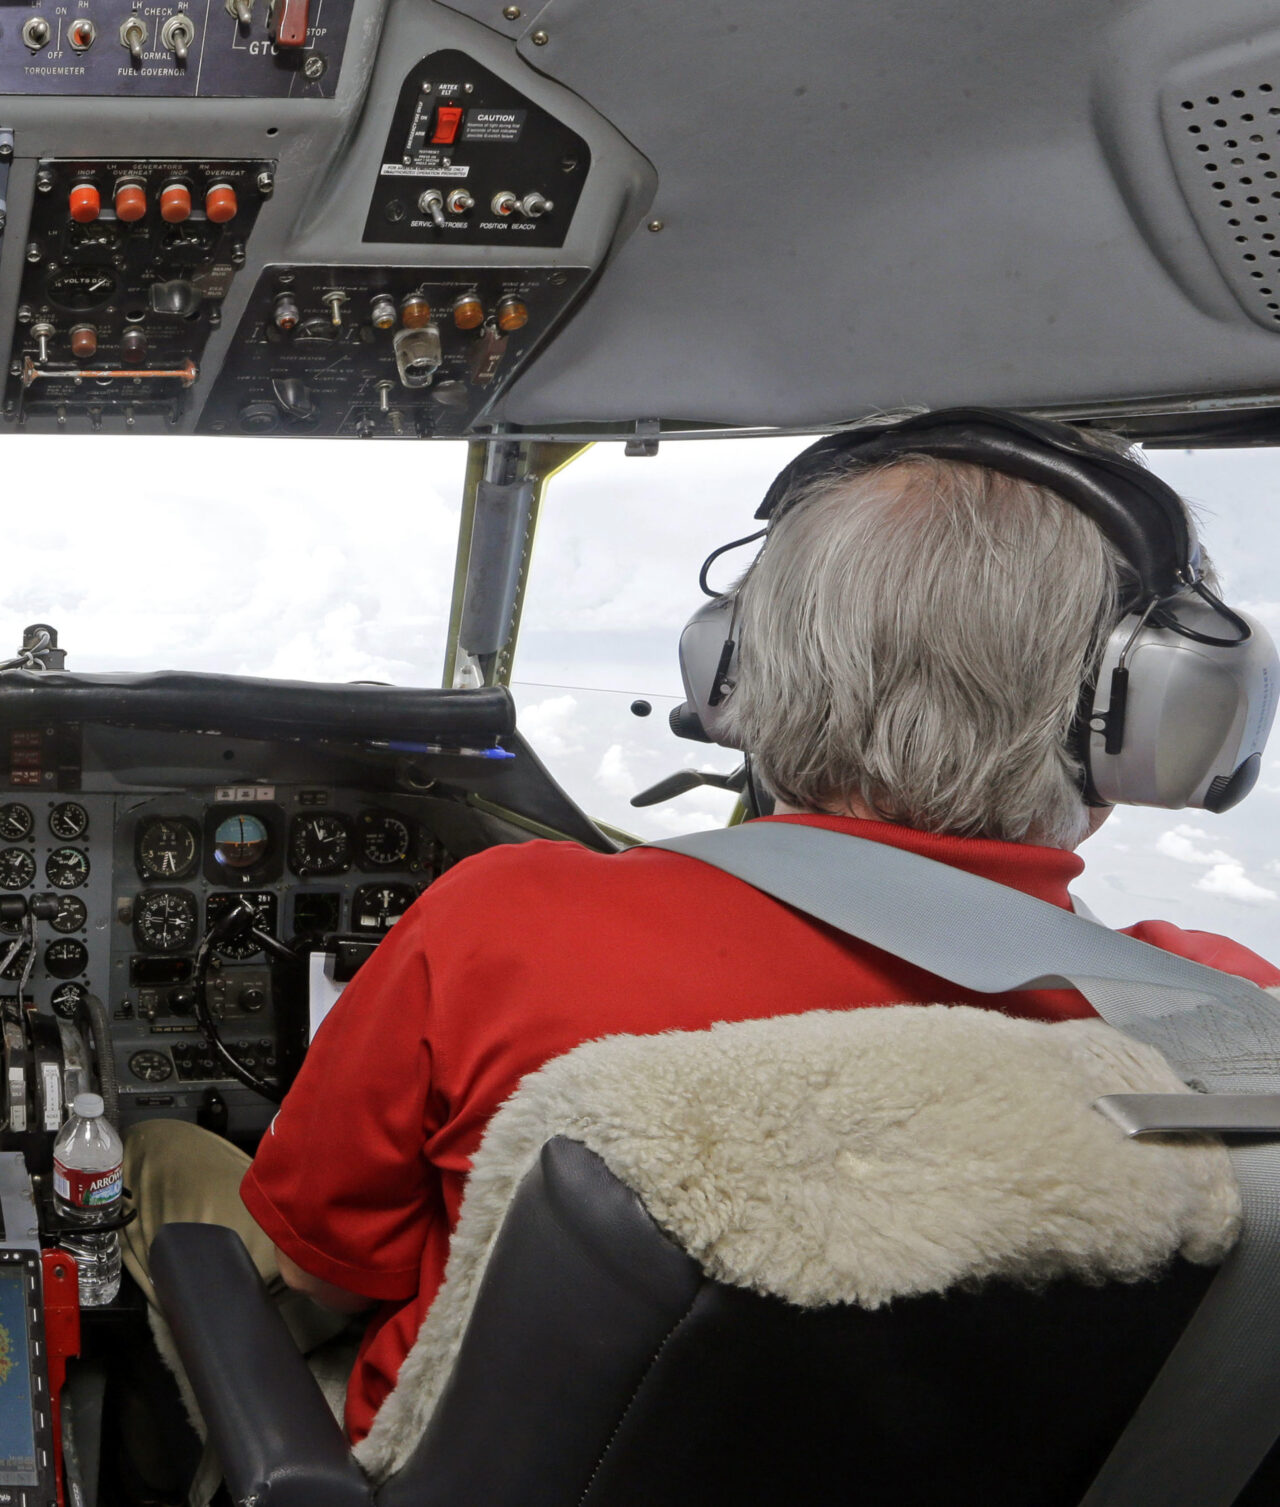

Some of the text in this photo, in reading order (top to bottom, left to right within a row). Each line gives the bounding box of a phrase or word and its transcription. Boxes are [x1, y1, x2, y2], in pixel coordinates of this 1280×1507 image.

[178, 1, 189, 9] RH
[144, 8, 173, 16] CHECK
[306, 28, 327, 36] STOP
[48, 51, 64, 59] OFF
[24, 67, 85, 75] TORQUEMETER
[118, 68, 185, 76] FUEL GOVERNOR
